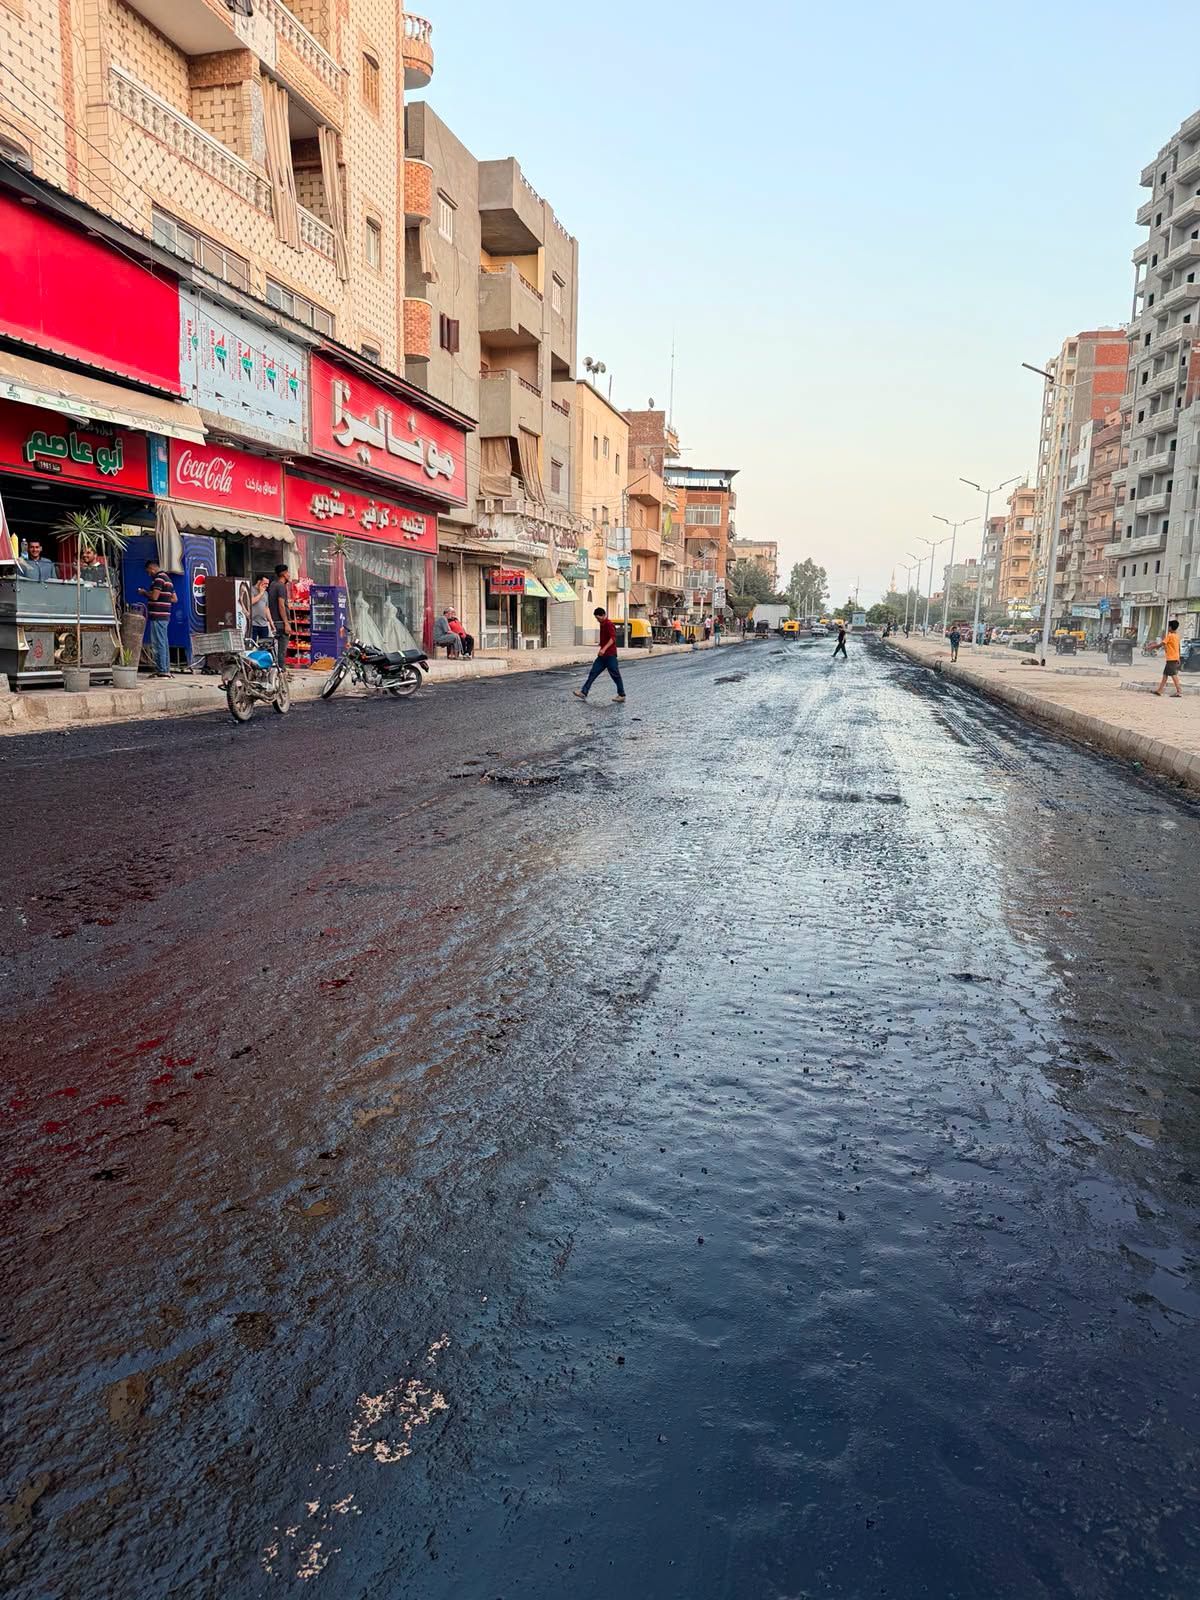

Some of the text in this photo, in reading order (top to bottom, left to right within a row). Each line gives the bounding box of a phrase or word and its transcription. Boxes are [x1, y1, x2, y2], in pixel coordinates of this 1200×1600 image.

[26, 431, 94, 465] عاصم
[331, 379, 456, 482] موناليزا
[97, 438, 124, 475] أبو
[176, 450, 236, 493] Coca-Cola
[194, 586, 206, 594] PEP
